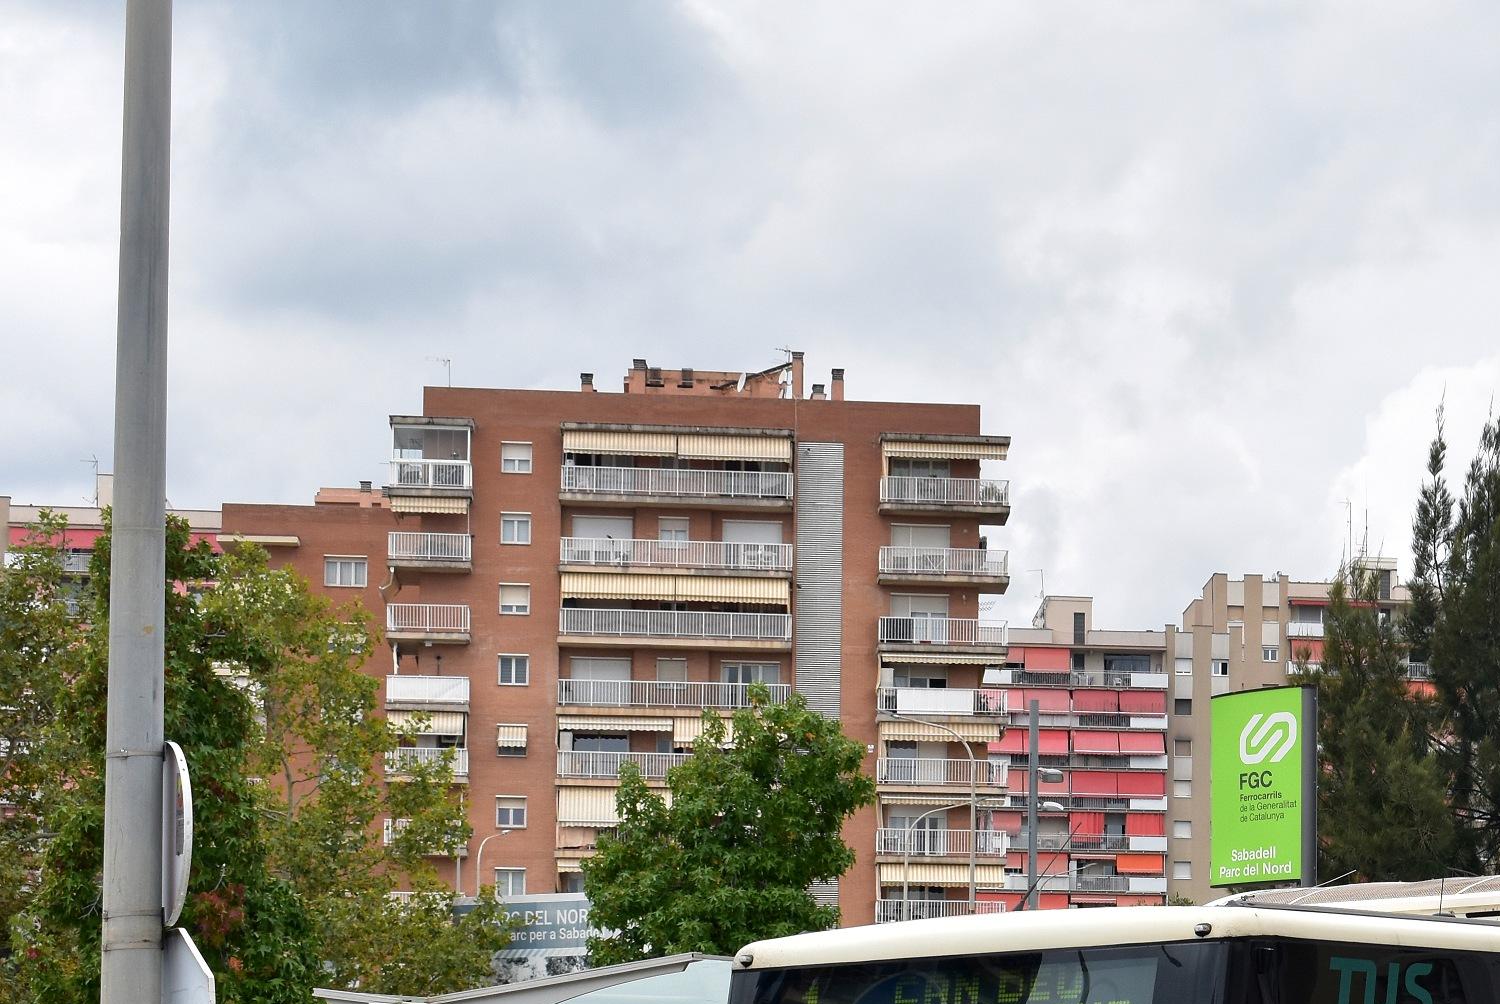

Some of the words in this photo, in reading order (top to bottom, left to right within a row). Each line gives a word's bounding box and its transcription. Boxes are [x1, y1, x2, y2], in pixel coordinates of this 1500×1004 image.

[1239, 770, 1273, 790] FGC
[1240, 791, 1282, 802] Ferrocarrils
[1240, 804, 1248, 813] de
[1249, 803, 1256, 812] la
[1256, 800, 1297, 811] Generalitat
[1240, 814, 1248, 823] de
[1249, 811, 1285, 822] Catalunya
[1231, 846, 1276, 862] Sabadell
[1219, 865, 1241, 879] Parc
[1243, 863, 1259, 877] del
[1263, 861, 1292, 875] Nord
[525, 909, 552, 926] DEL
[556, 908, 589, 926] NOR
[529, 930, 546, 943] per
[550, 931, 556, 940] a
[997, 968, 1083, 1003] DEU
